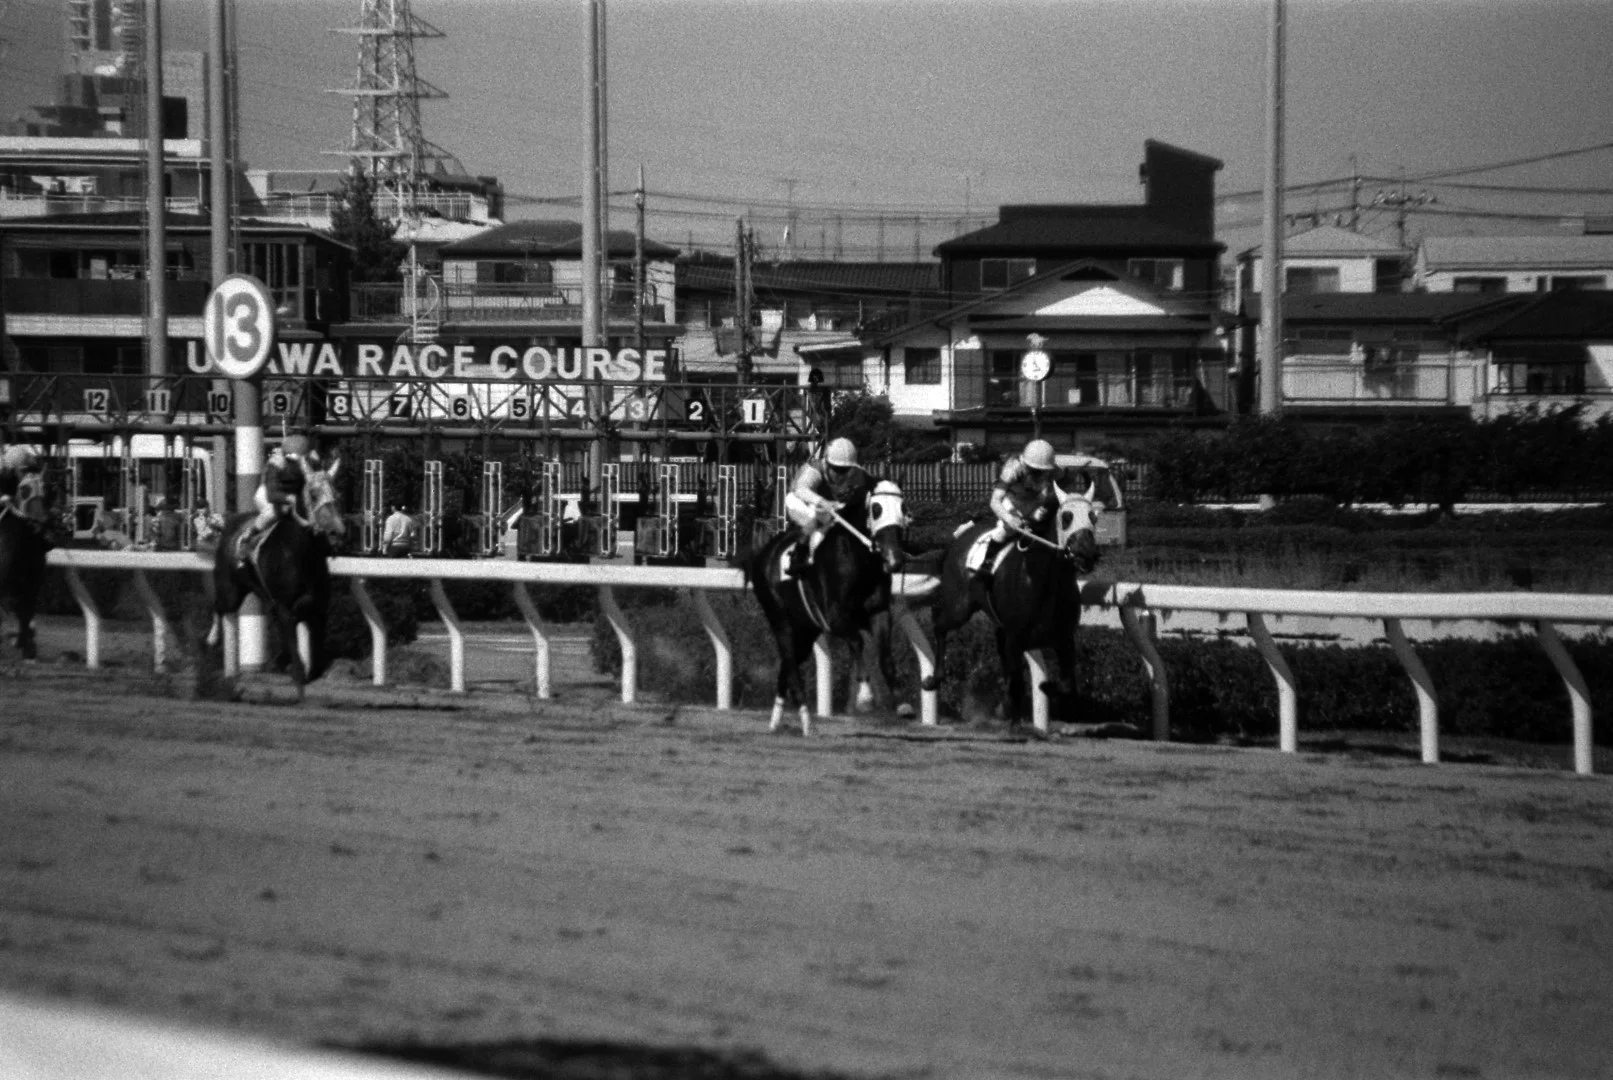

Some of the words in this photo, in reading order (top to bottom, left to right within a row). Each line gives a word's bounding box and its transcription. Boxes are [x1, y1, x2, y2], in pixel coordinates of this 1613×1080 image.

[214, 291, 261, 362] 13
[187, 340, 343, 376] UWA
[357, 344, 475, 378] RACE
[490, 345, 666, 381] COURSE
[87, 391, 105, 411] 12
[151, 392, 166, 412] 11
[211, 393, 228, 413] 10
[273, 393, 288, 412] 9
[333, 395, 349, 414] 8
[393, 396, 408, 415] 7
[453, 398, 468, 417] 6
[512, 398, 527, 418] 5
[570, 399, 586, 418] 4
[629, 400, 645, 419] 3
[689, 401, 703, 421] 2
